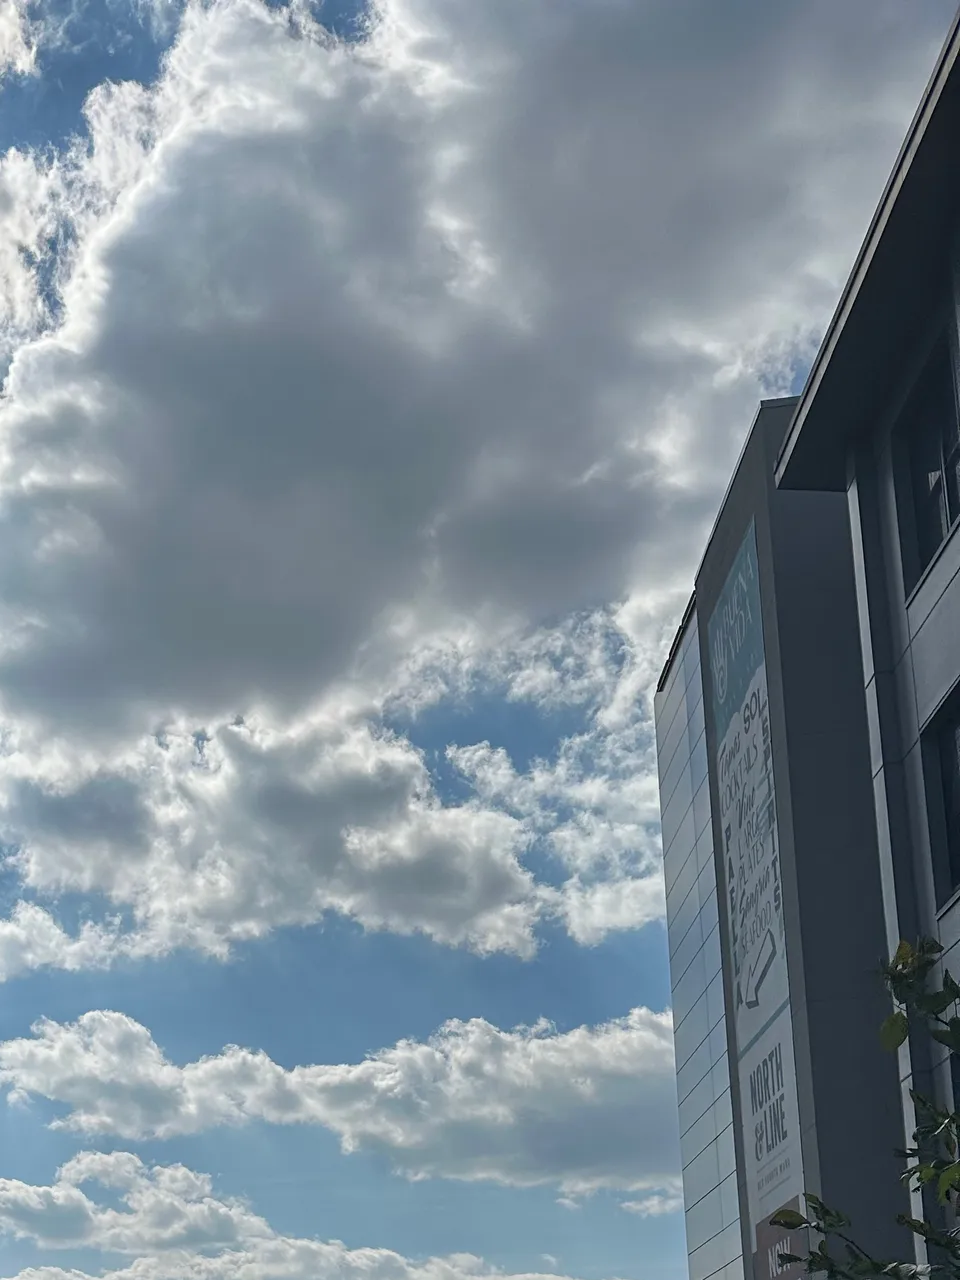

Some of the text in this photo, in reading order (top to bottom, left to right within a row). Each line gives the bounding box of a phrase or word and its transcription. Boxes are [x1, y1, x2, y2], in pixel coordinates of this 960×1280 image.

[743, 688, 767, 735] SOL
[738, 837, 765, 890] PLATES
[724, 822, 744, 1011] PAELLA
[749, 1043, 784, 1116] NORTH
